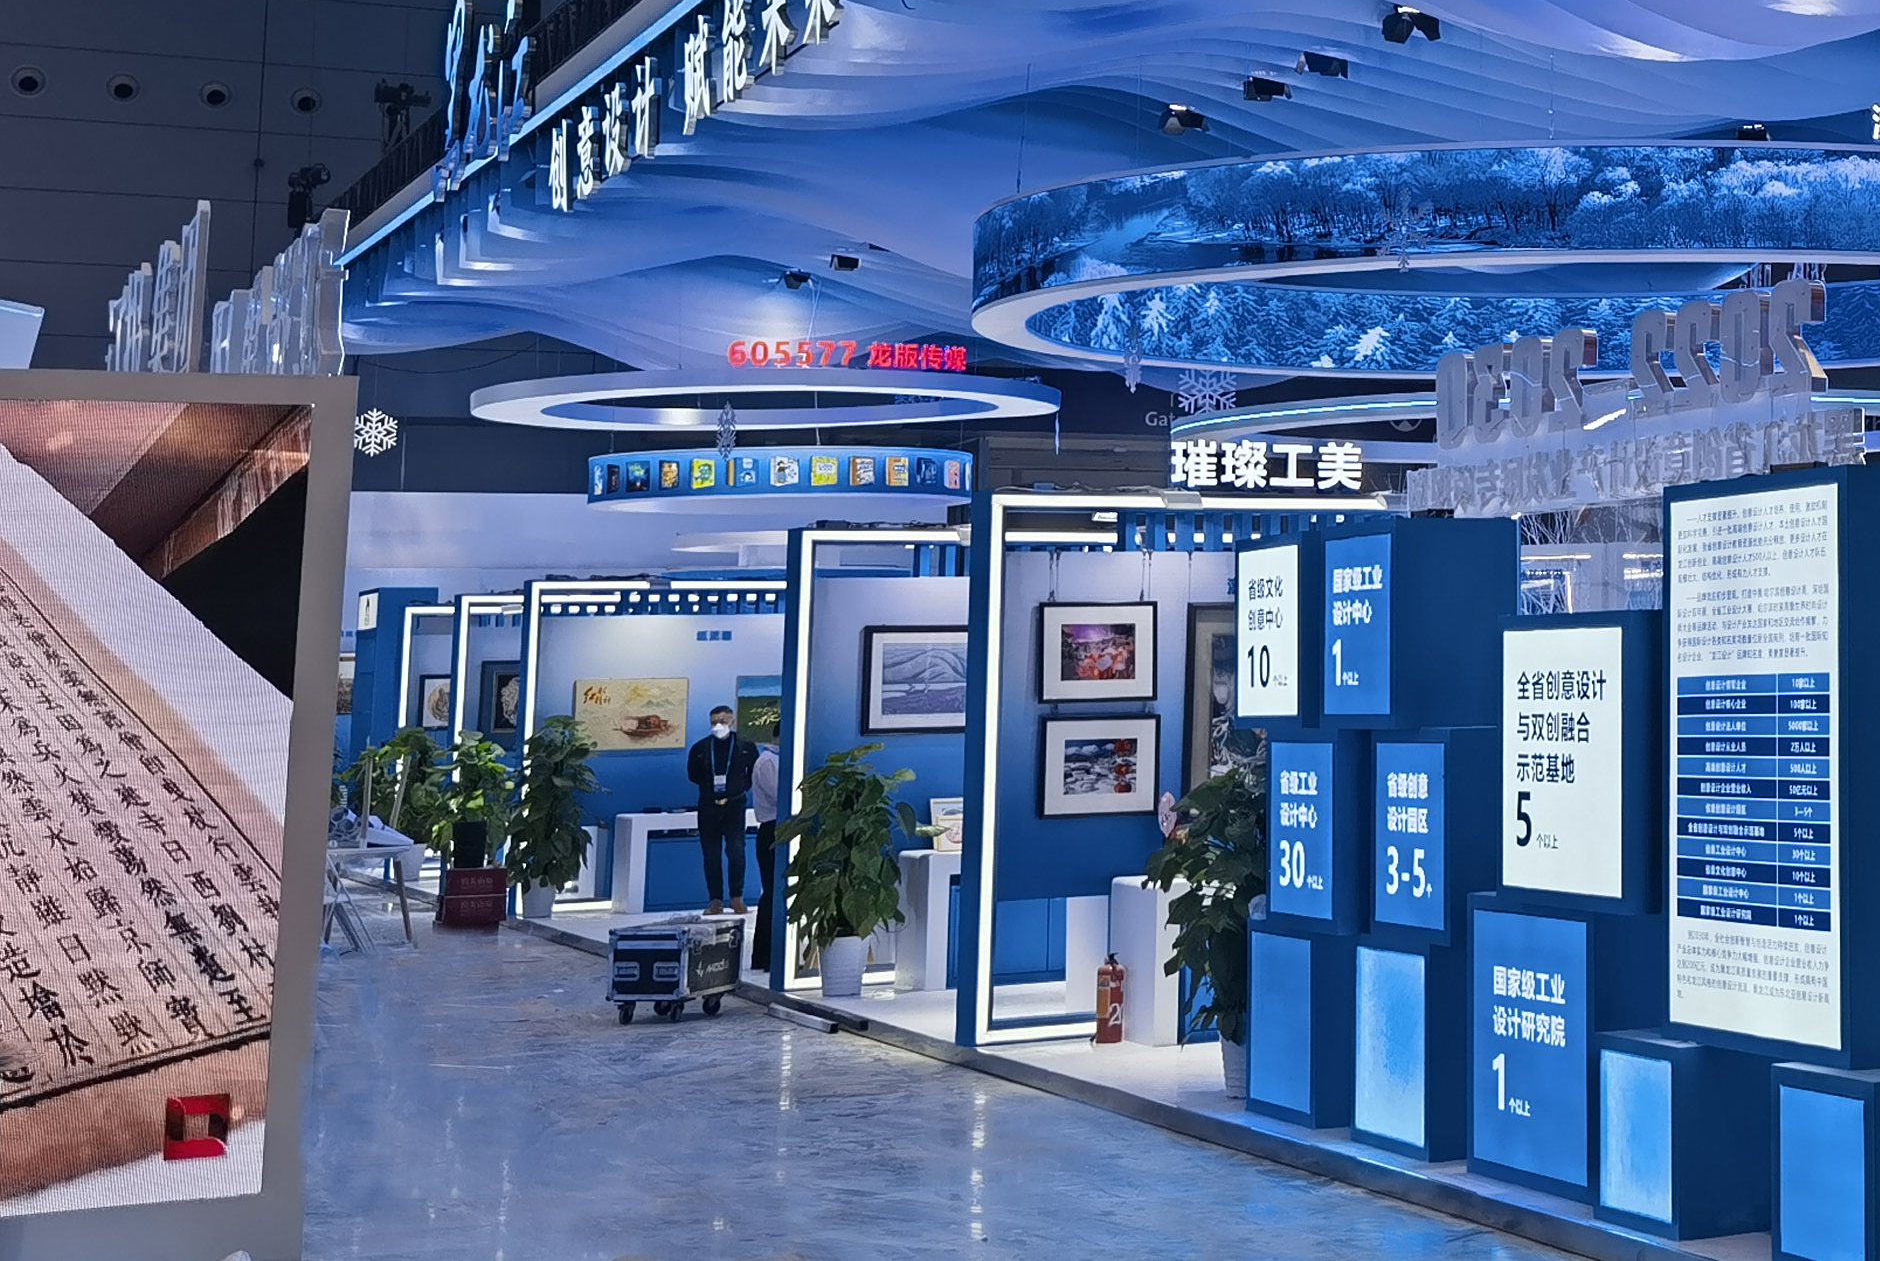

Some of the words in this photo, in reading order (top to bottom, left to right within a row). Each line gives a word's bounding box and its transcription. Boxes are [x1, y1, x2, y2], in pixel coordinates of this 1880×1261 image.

[550, 55, 661, 212] 创意设计
[866, 340, 968, 371] 龙版传媒
[1170, 438, 1363, 490] 璀璨工美
[1248, 575, 1283, 600] 省级文化
[1333, 564, 1383, 594] 国家级工业
[1248, 607, 1283, 631] 创意中心
[1332, 599, 1373, 626] 设计中心
[1248, 644, 1270, 688] 10
[1332, 639, 1342, 687] 1
[1517, 669, 1607, 701] 全省创意设计
[1517, 711, 1590, 743] 与双创融合
[1280, 770, 1318, 796] 省级工业
[1517, 753, 1576, 784] 示范基地
[1387, 772, 1429, 799] 省级创意
[1280, 802, 1318, 829] 设计中心
[1387, 806, 1429, 834] 设计园区
[1516, 791, 1533, 848] 5
[1536, 833, 1558, 849] 个以上
[1279, 840, 1306, 889] 30
[1493, 965, 1566, 1005] 国家级工业
[1492, 1005, 1566, 1048] 设计研究院
[1492, 1053, 1505, 1111] 1
[1508, 1097, 1531, 1117] 个以上
